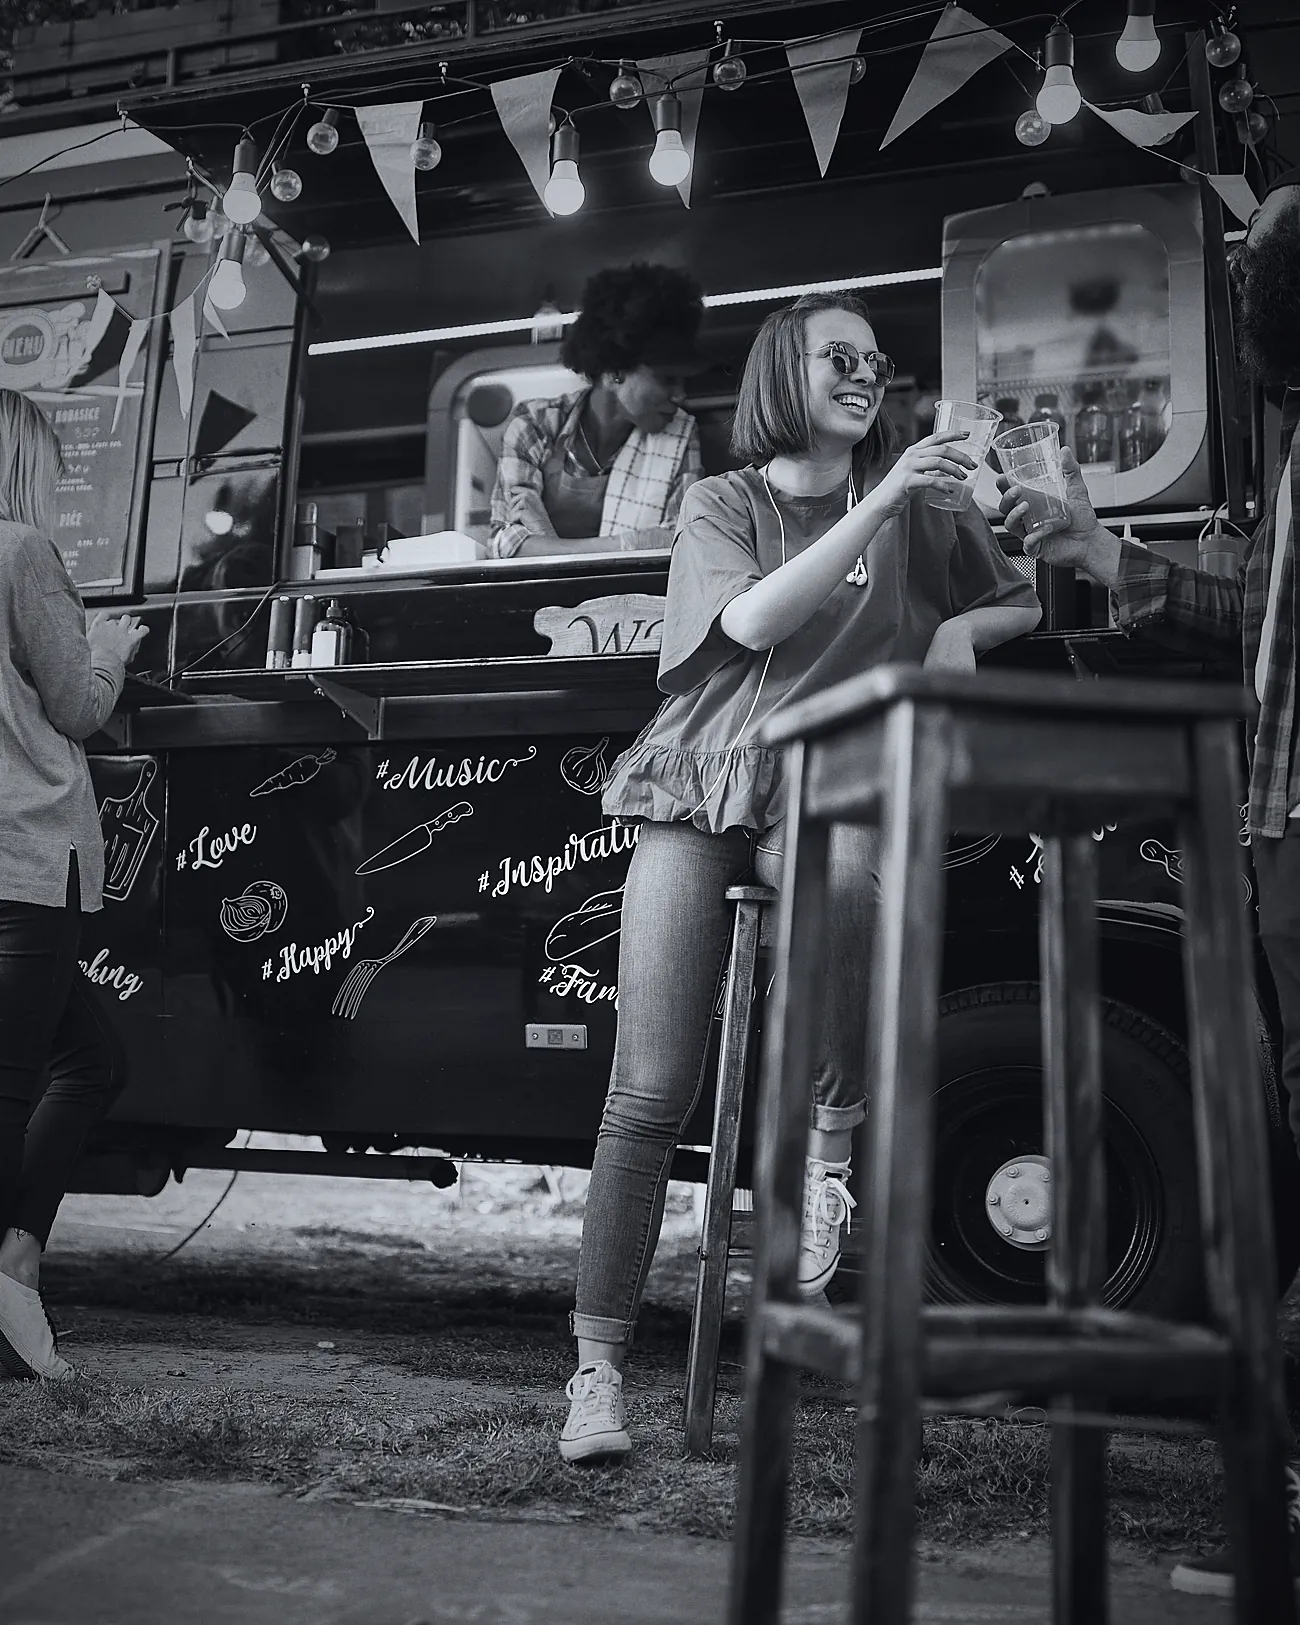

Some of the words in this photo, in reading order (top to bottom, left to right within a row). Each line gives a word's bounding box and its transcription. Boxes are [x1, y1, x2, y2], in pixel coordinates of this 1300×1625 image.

[376, 745, 537, 790] #Music
[175, 823, 257, 871] #Love
[261, 906, 375, 983] #Happy
[538, 963, 620, 1011] #Fan
